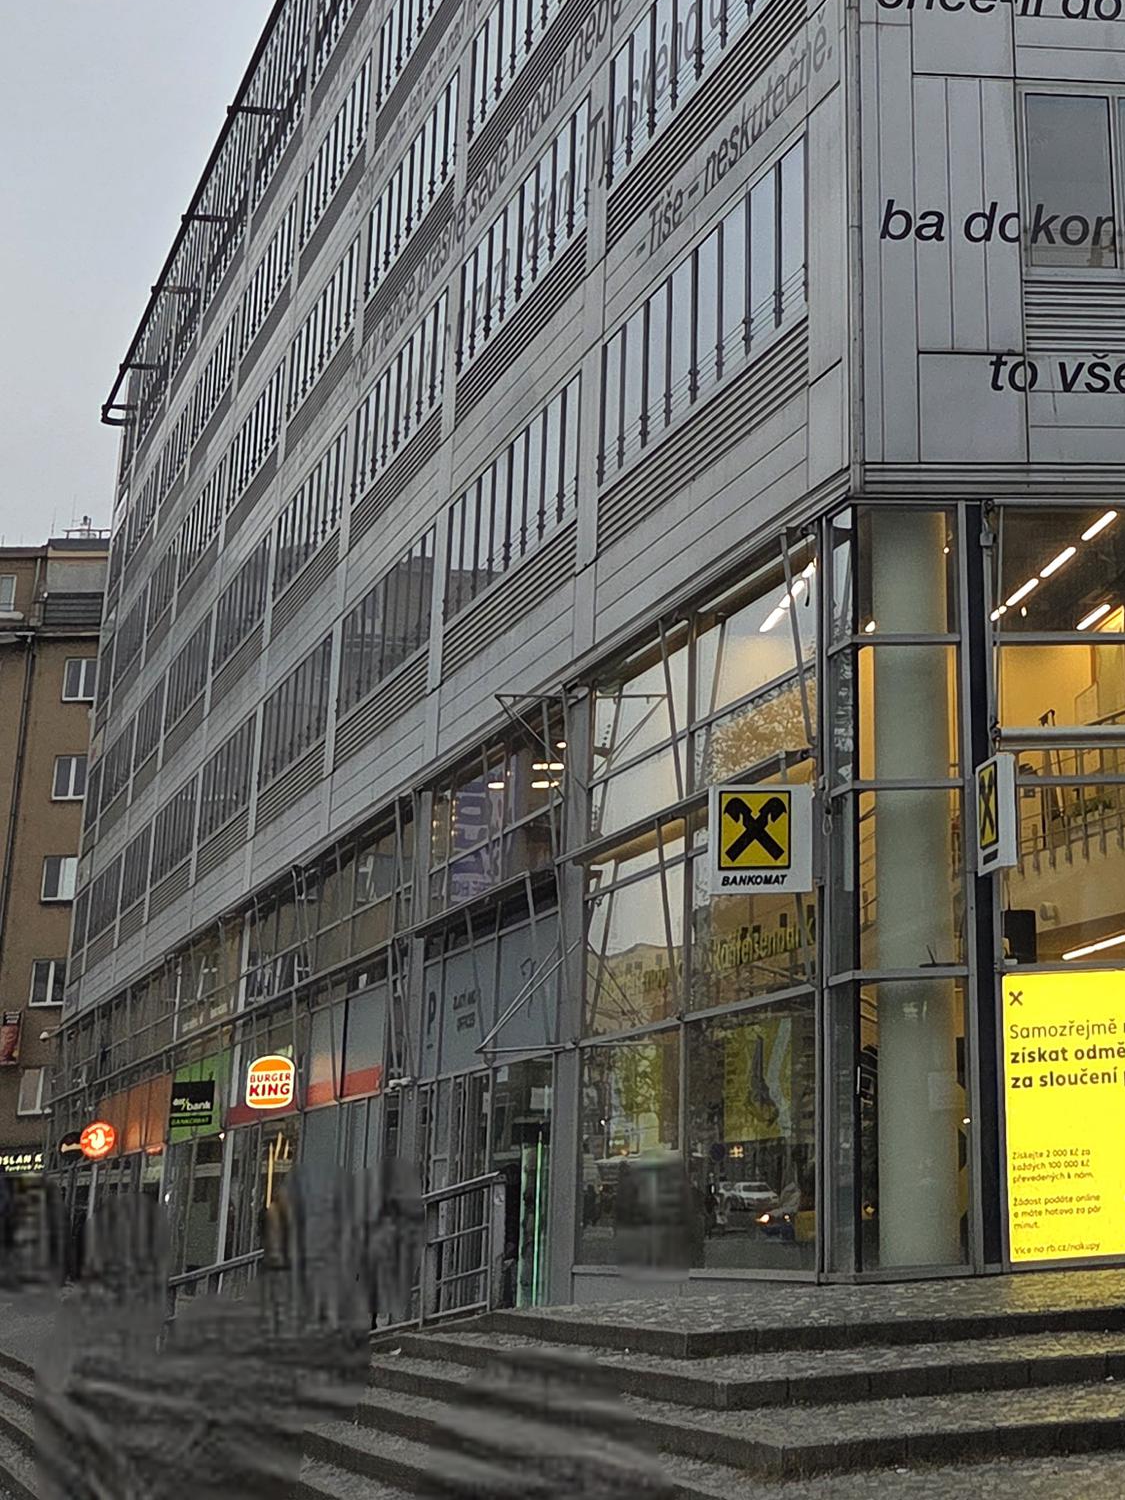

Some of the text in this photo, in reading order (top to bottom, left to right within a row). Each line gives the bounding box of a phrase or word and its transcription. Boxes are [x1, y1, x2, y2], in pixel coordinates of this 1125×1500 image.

[648, 169, 683, 262] Tiše
[879, 199, 947, 243] ba
[988, 351, 1040, 393] to
[721, 873, 788, 887] BANKOMAT
[1009, 1017, 1118, 1041] Samozřejmě
[249, 1072, 292, 1083] BURGER
[1010, 1075, 1034, 1088] za
[1039, 1066, 1119, 1087] sloučení
[248, 1083, 290, 1097] KING
